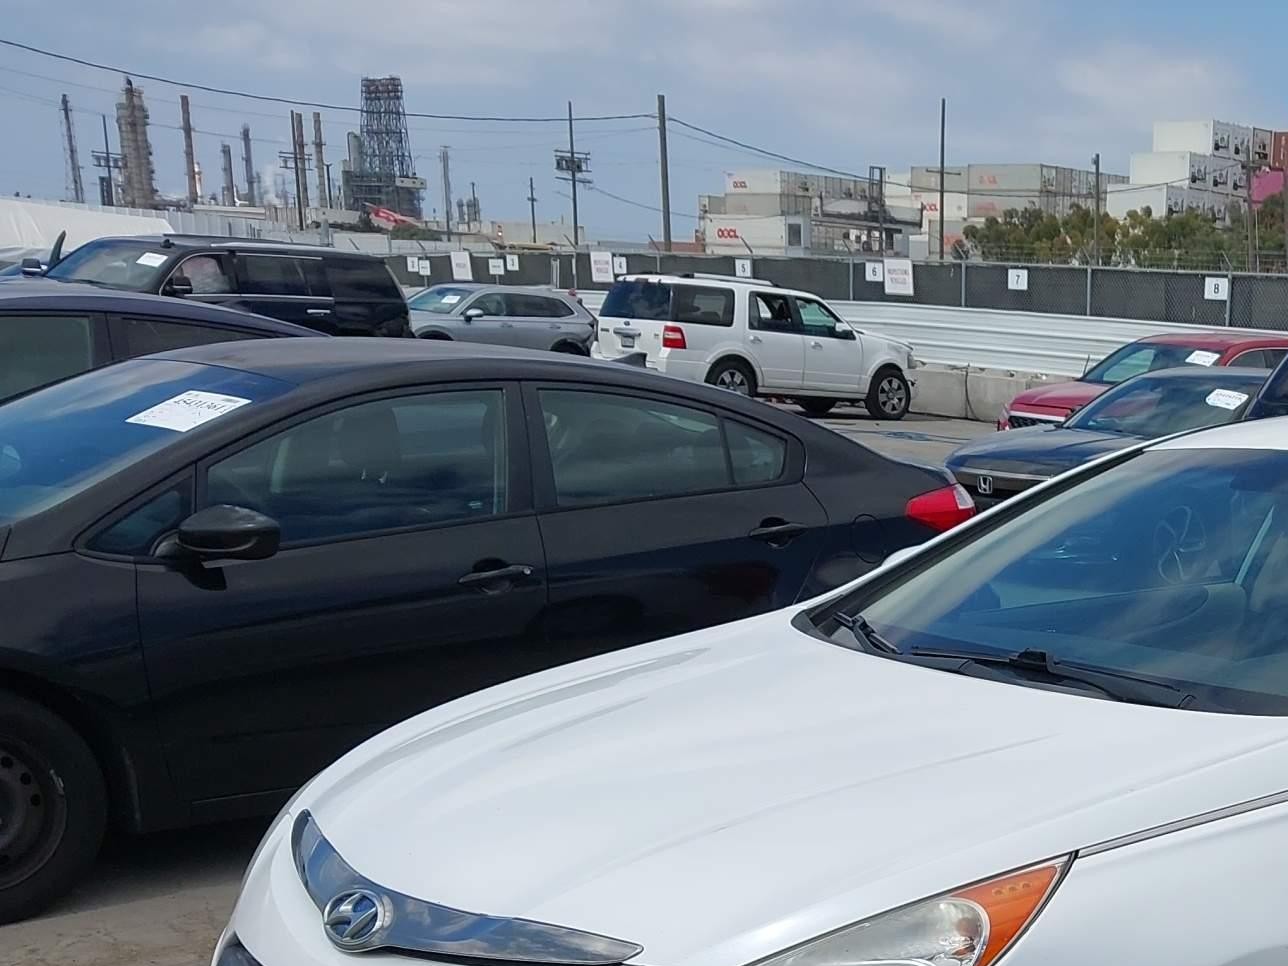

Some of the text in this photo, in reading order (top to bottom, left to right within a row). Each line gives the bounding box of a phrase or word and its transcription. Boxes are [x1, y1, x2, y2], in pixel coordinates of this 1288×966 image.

[716, 228, 740, 239] OOCL
[871, 266, 877, 277] 6
[1015, 274, 1021, 285] 7
[1213, 283, 1220, 294] 8
